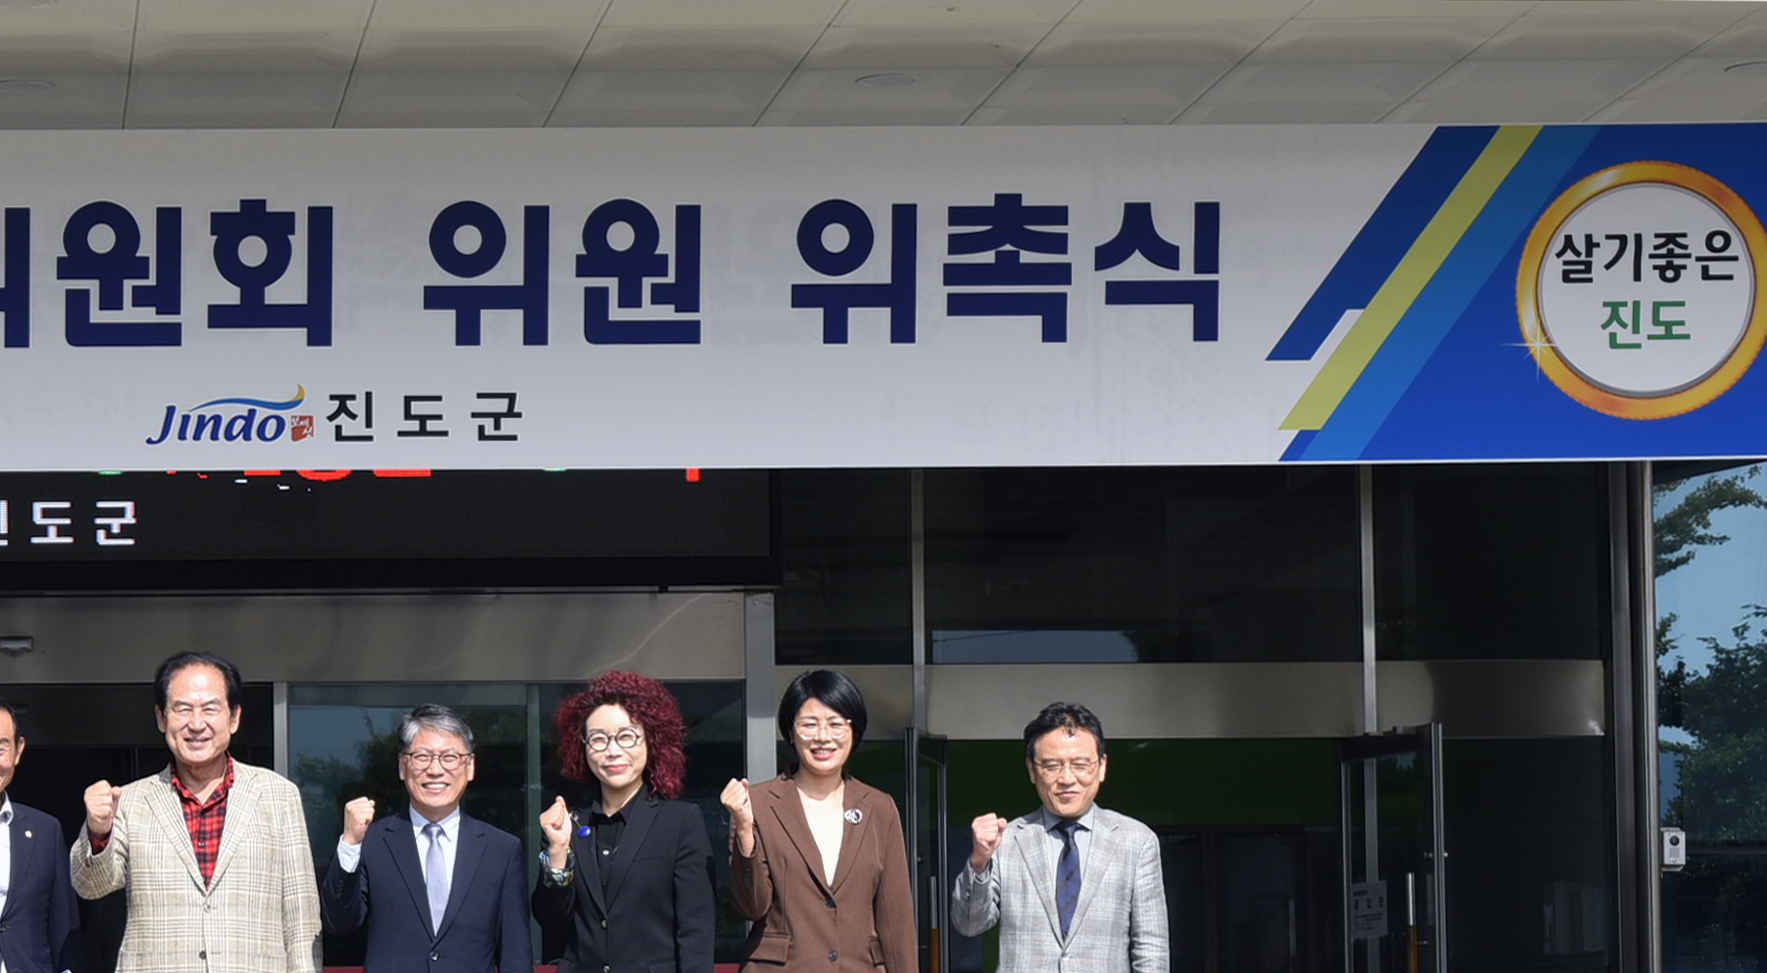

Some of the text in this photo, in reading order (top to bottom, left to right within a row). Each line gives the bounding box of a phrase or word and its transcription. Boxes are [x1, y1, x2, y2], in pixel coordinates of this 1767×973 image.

[423, 198, 702, 346] 위원
[791, 193, 1220, 345] 위촉식
[1554, 229, 1740, 284] 살기좋은
[1600, 300, 1691, 350] 진도
[146, 404, 285, 445] Jindo
